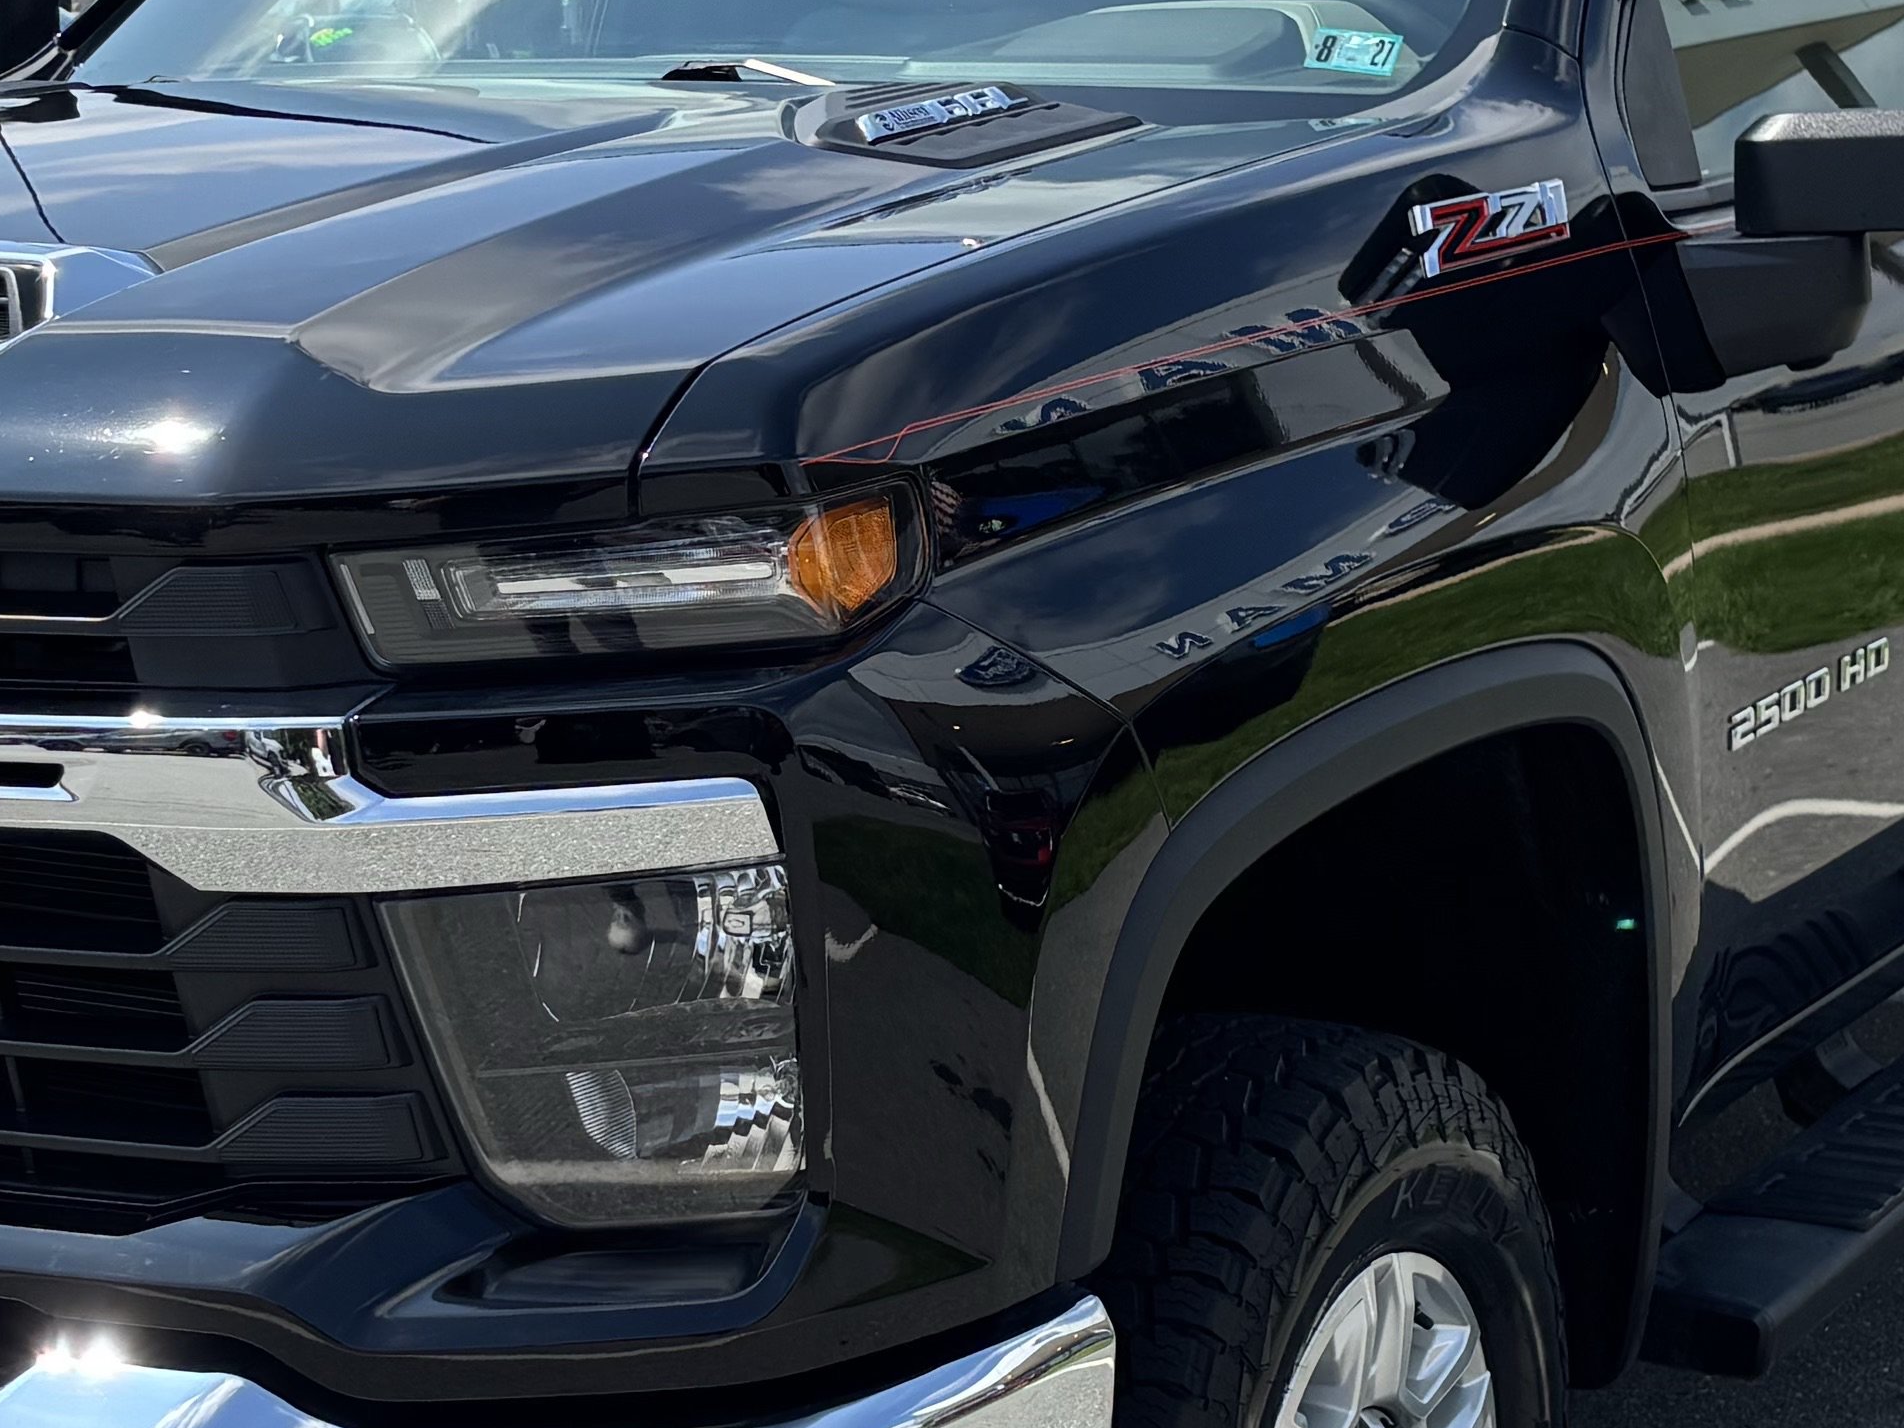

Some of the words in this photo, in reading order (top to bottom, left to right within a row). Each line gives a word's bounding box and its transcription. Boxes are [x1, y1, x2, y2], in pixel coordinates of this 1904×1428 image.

[1315, 35, 1337, 62] 8
[1370, 39, 1396, 69] 27
[1408, 177, 1571, 278] Z71
[1727, 666, 1831, 752] 2500
[1837, 636, 1890, 693] HD
